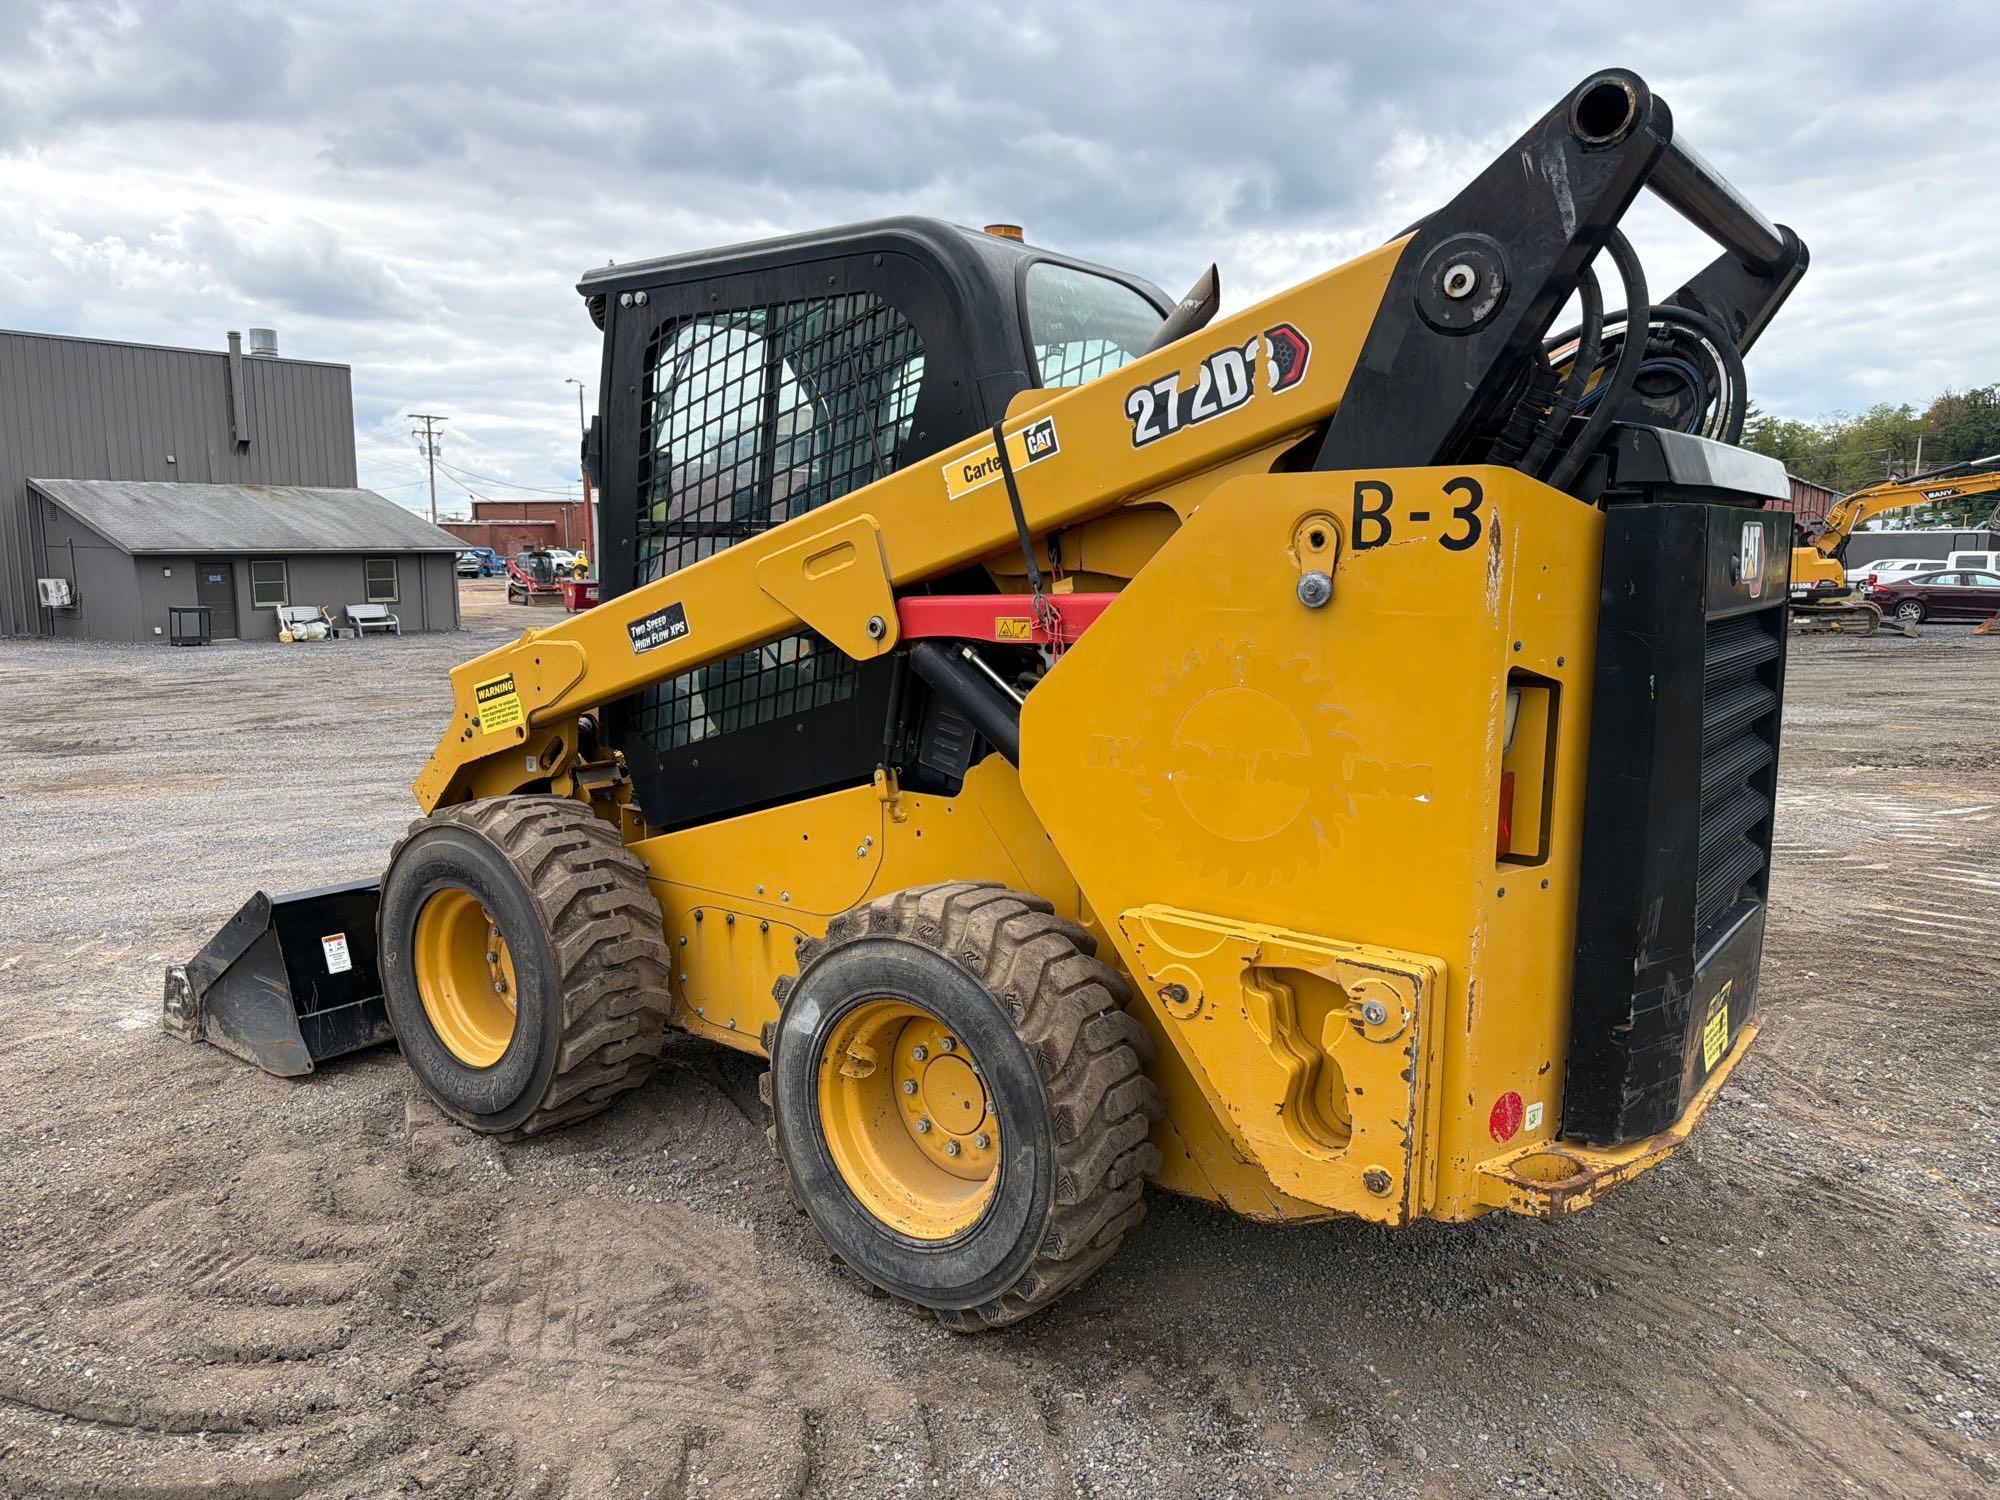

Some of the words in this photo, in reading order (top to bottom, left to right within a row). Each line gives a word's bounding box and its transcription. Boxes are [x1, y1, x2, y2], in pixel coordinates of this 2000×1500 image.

[963, 456, 1003, 484] Carte
[1027, 428, 1052, 455] CAT
[1928, 488, 1953, 499] SANY
[1351, 476, 1484, 551] B-3
[1741, 525, 1761, 579] CAT
[670, 621, 685, 637] XPS
[478, 680, 514, 700] WARNING
